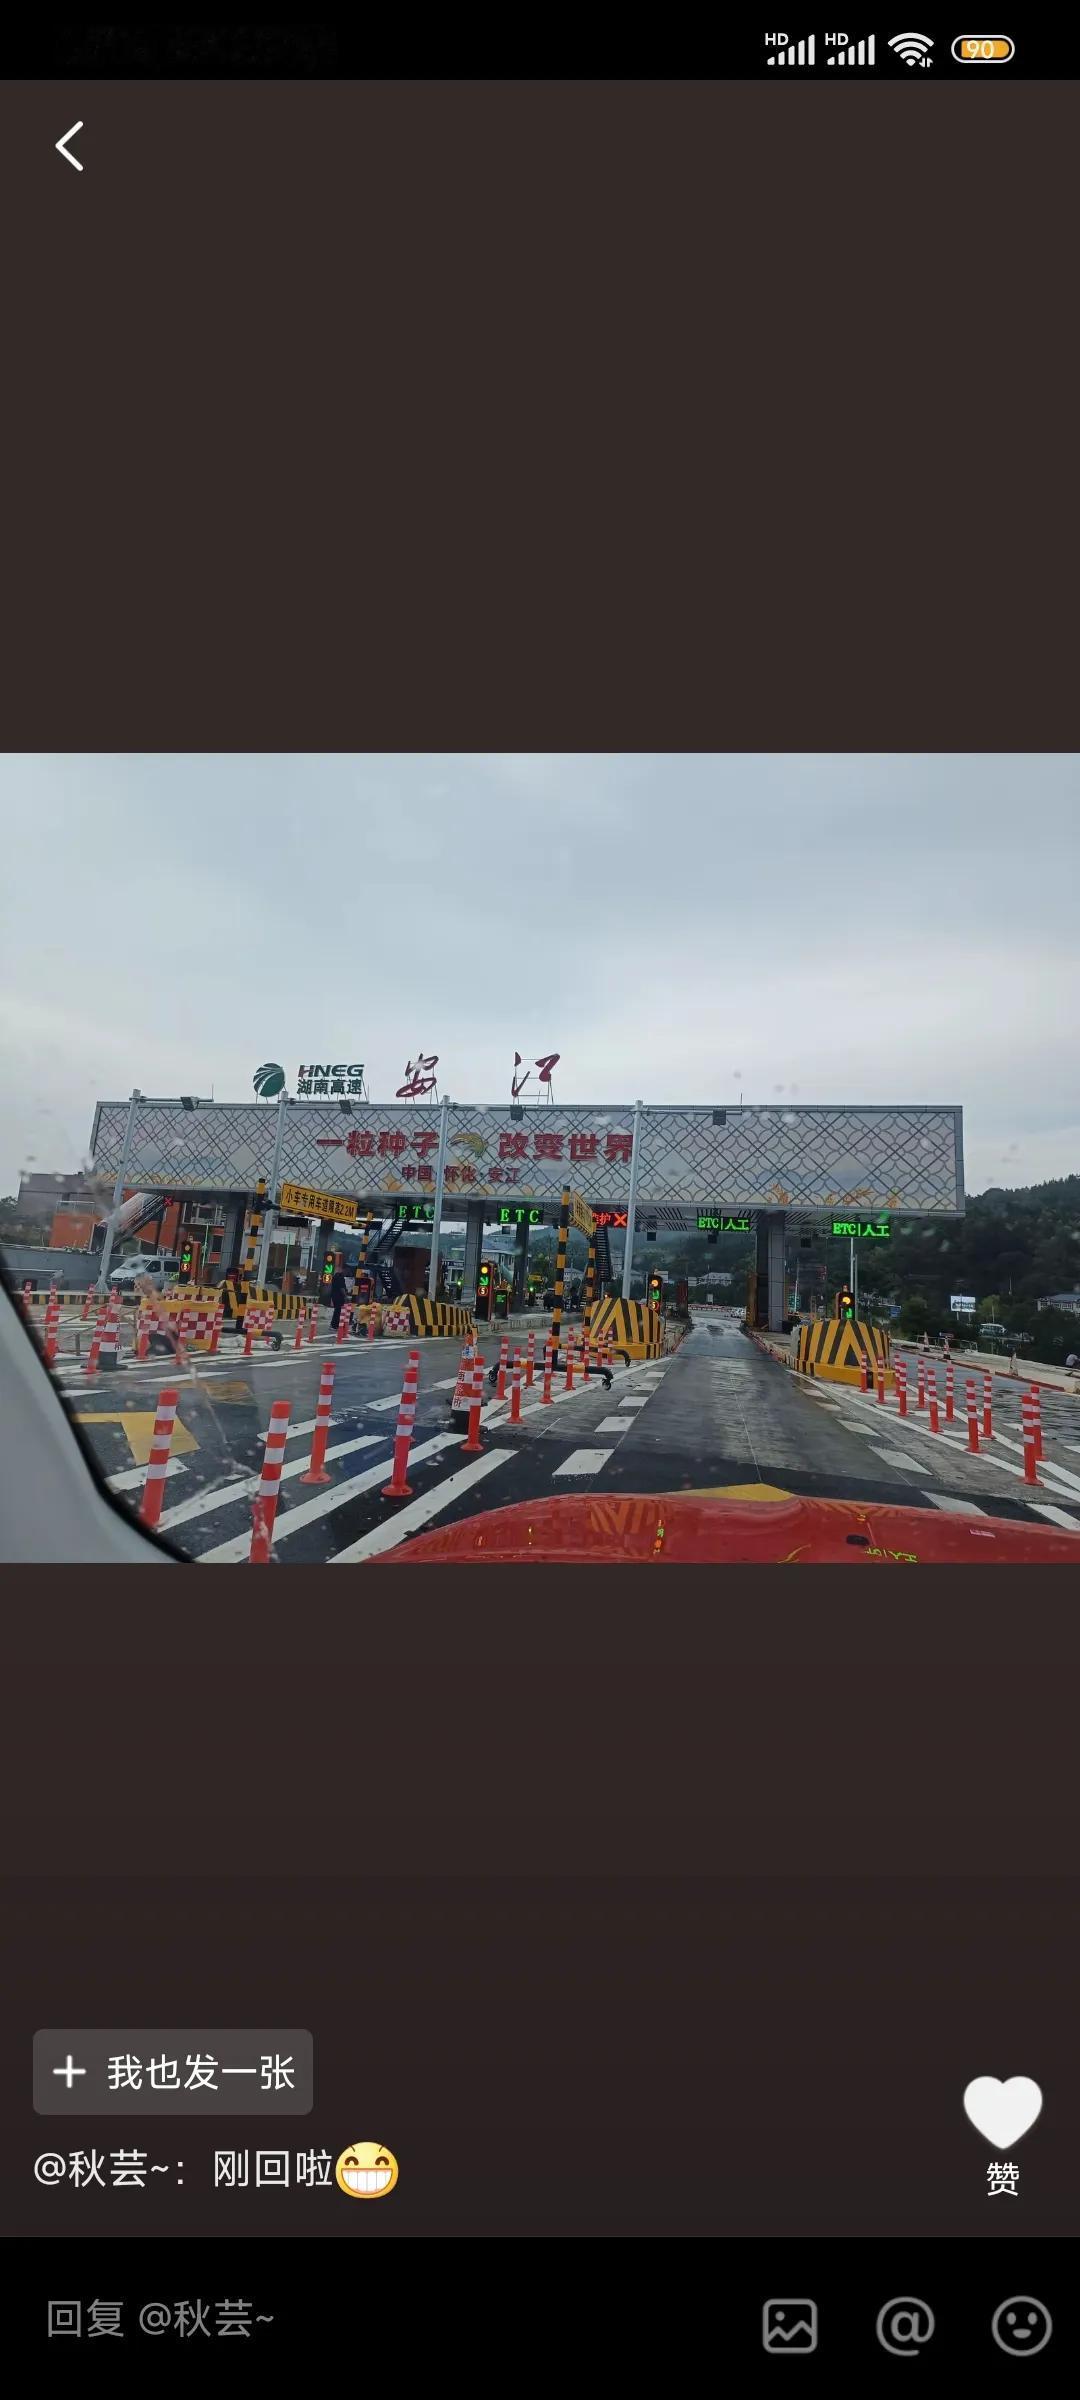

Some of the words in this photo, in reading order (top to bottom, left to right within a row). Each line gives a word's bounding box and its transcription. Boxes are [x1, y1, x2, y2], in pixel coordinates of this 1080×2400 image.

[298, 1064, 364, 1078] HNEG
[297, 1079, 362, 1095] 湖南高速
[316, 1130, 439, 1158] 一粒种子
[498, 1132, 634, 1163] 改变世界
[500, 1209, 540, 1223] ETC
